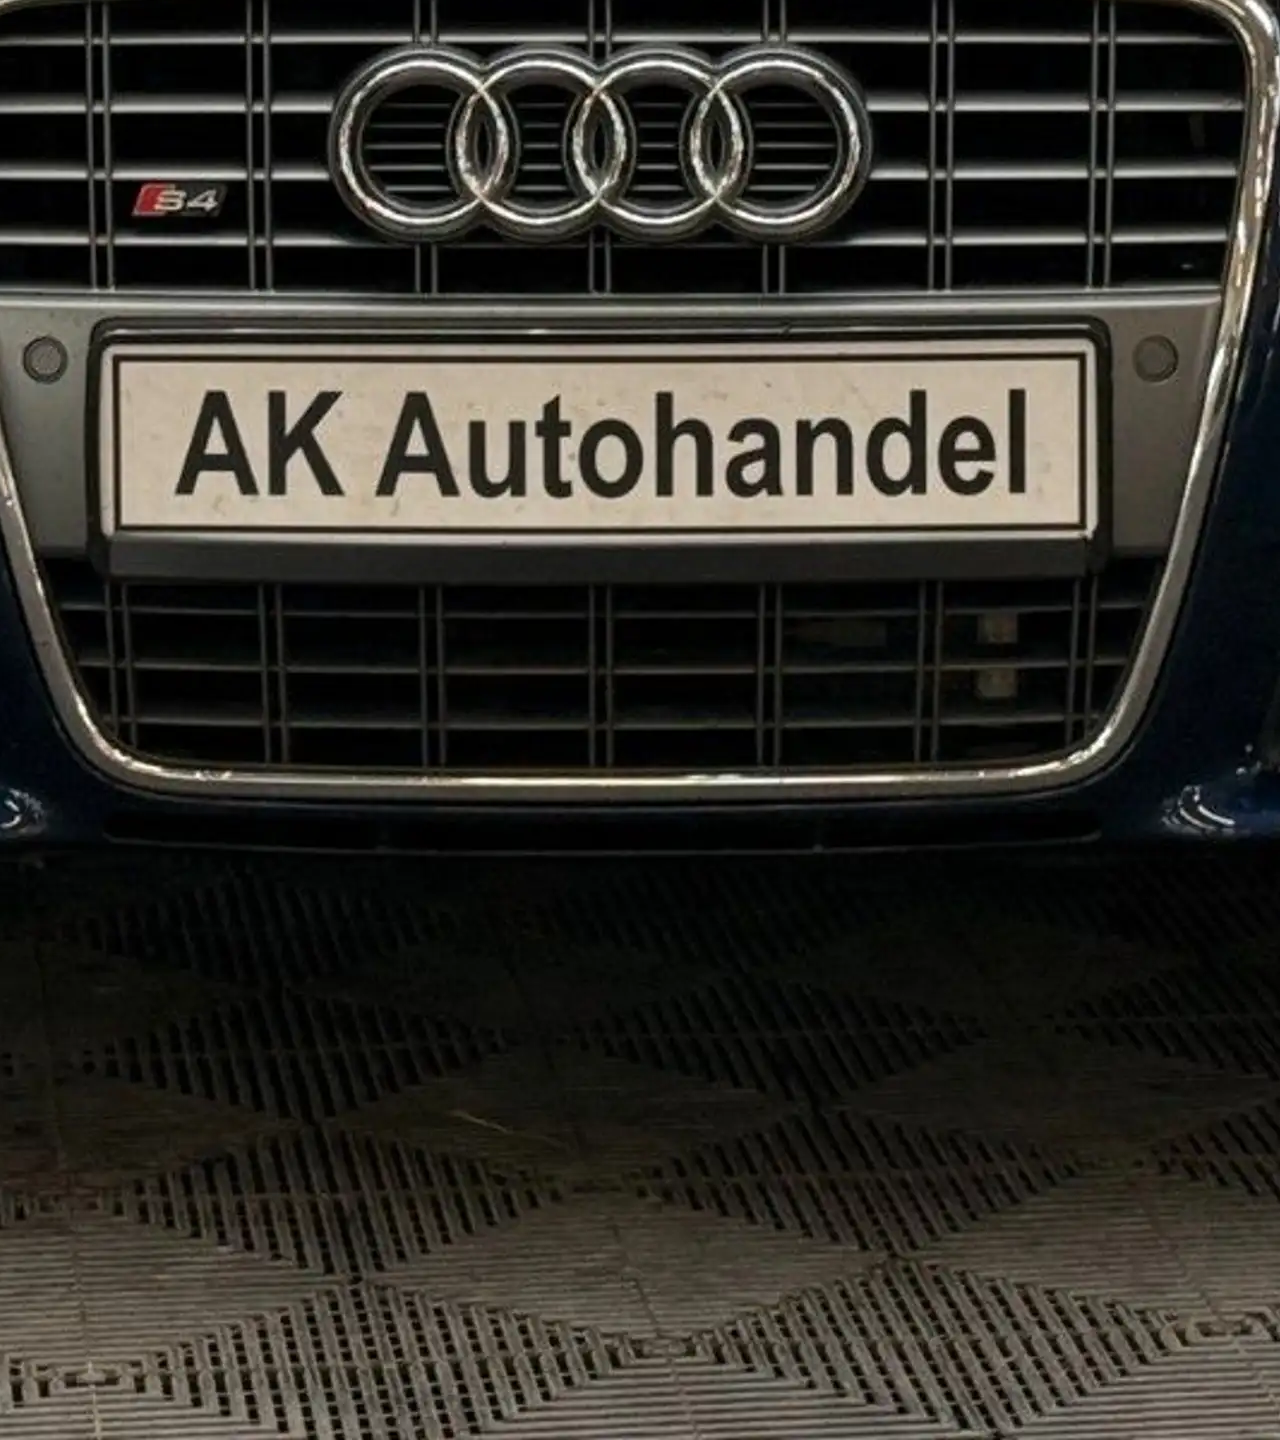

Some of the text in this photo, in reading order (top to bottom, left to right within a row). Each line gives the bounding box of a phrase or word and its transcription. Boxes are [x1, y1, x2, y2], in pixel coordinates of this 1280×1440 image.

[152, 187, 219, 214] S4
[173, 388, 1028, 498] AK Autohandel
